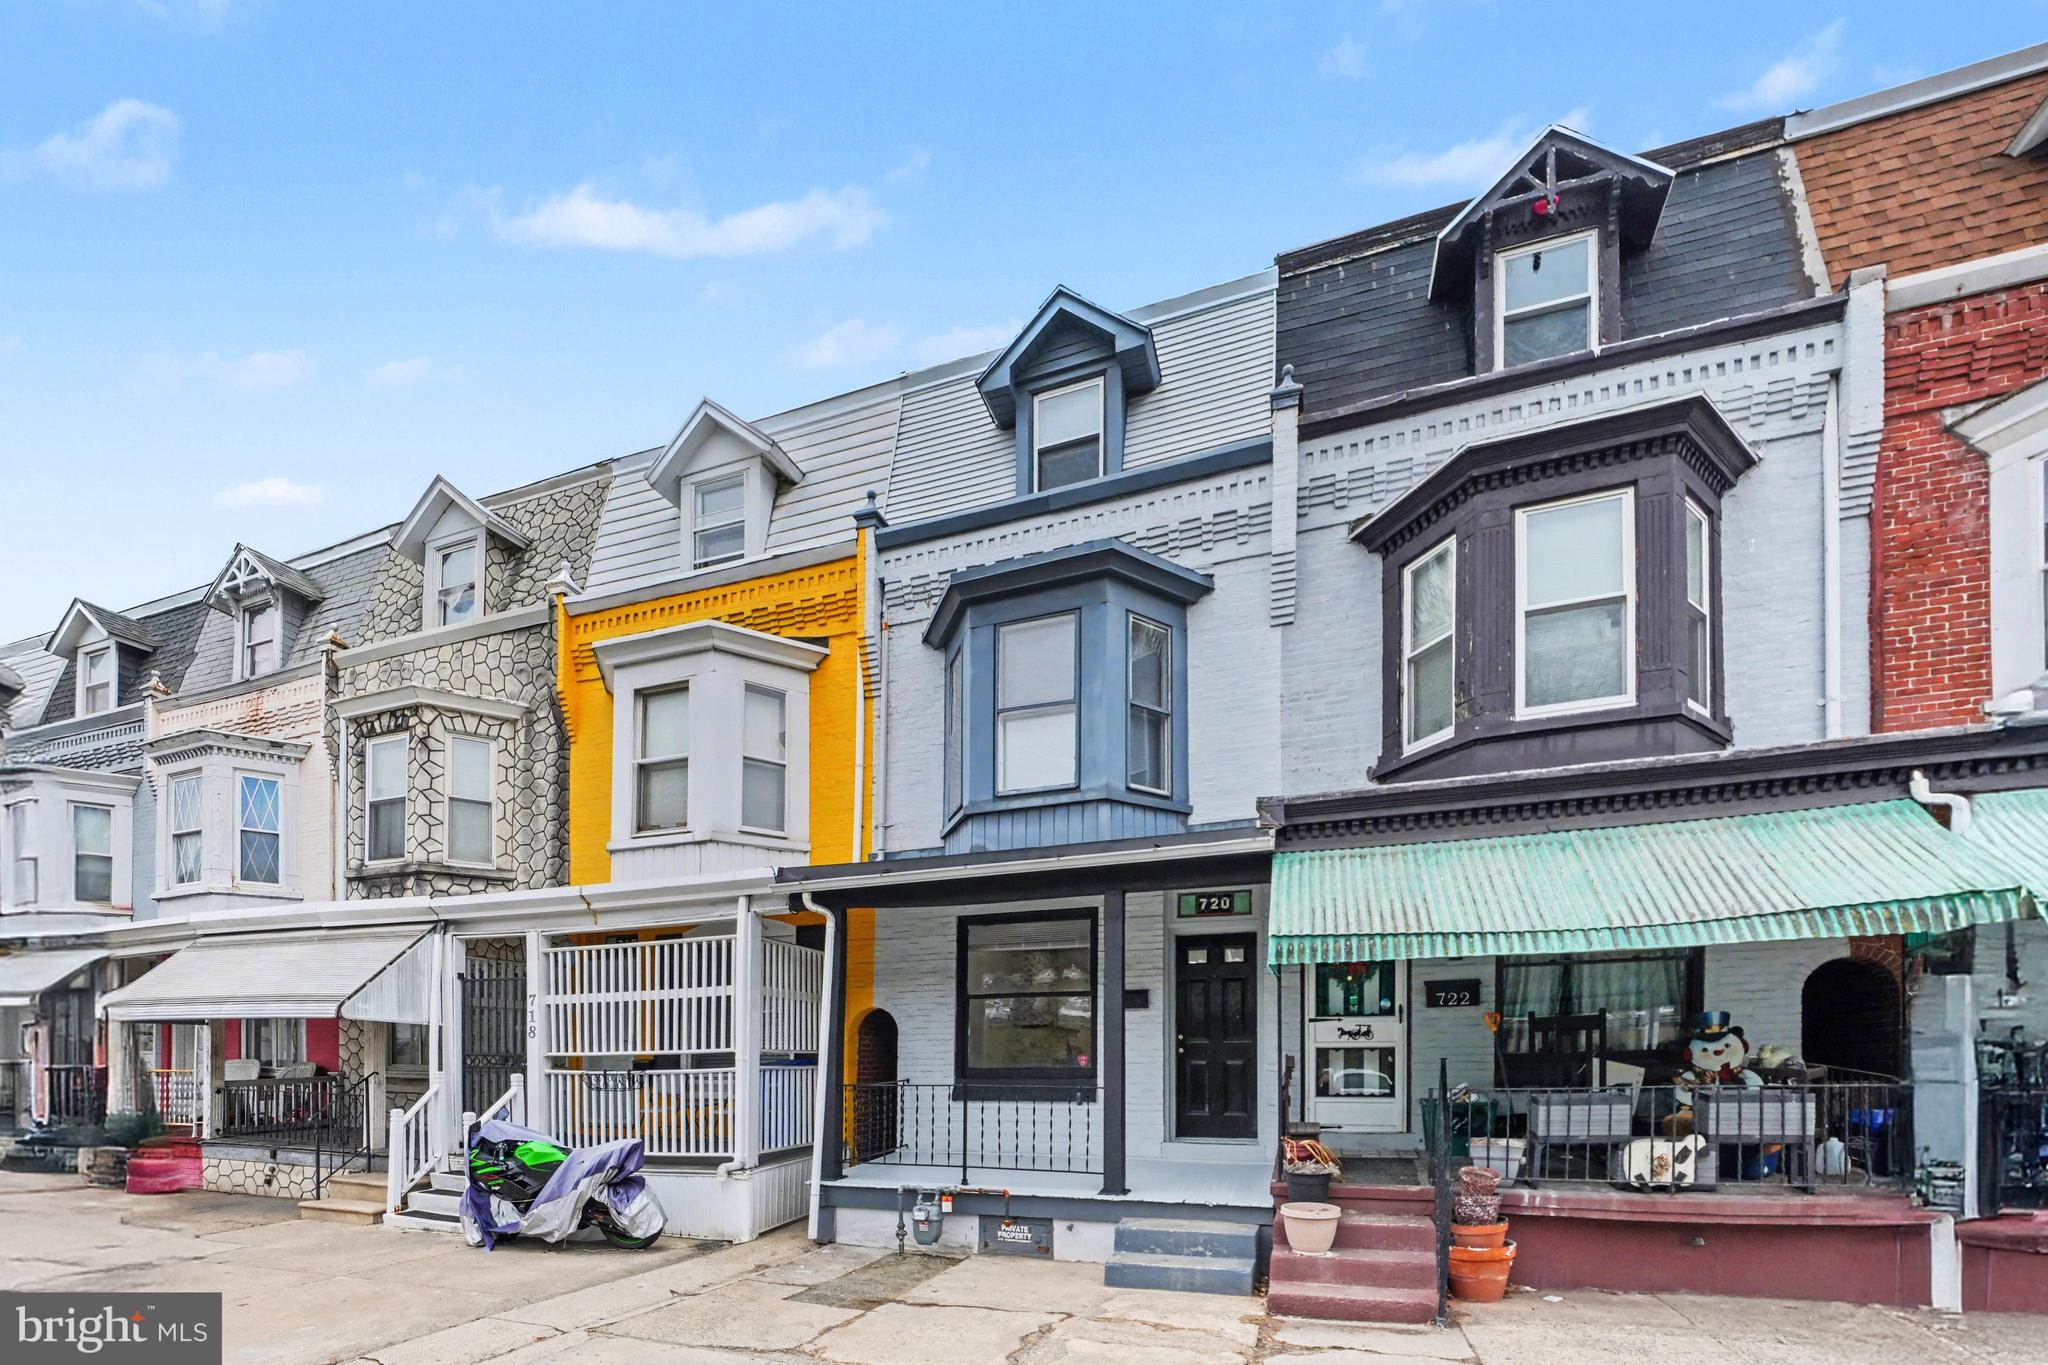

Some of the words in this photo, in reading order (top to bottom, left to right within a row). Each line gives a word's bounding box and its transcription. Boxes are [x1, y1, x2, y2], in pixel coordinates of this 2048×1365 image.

[1199, 897, 1230, 911] 720
[1435, 991, 1470, 1006] 722
[528, 993, 537, 1039] 718
[997, 1230, 1032, 1240] PROPERTY
